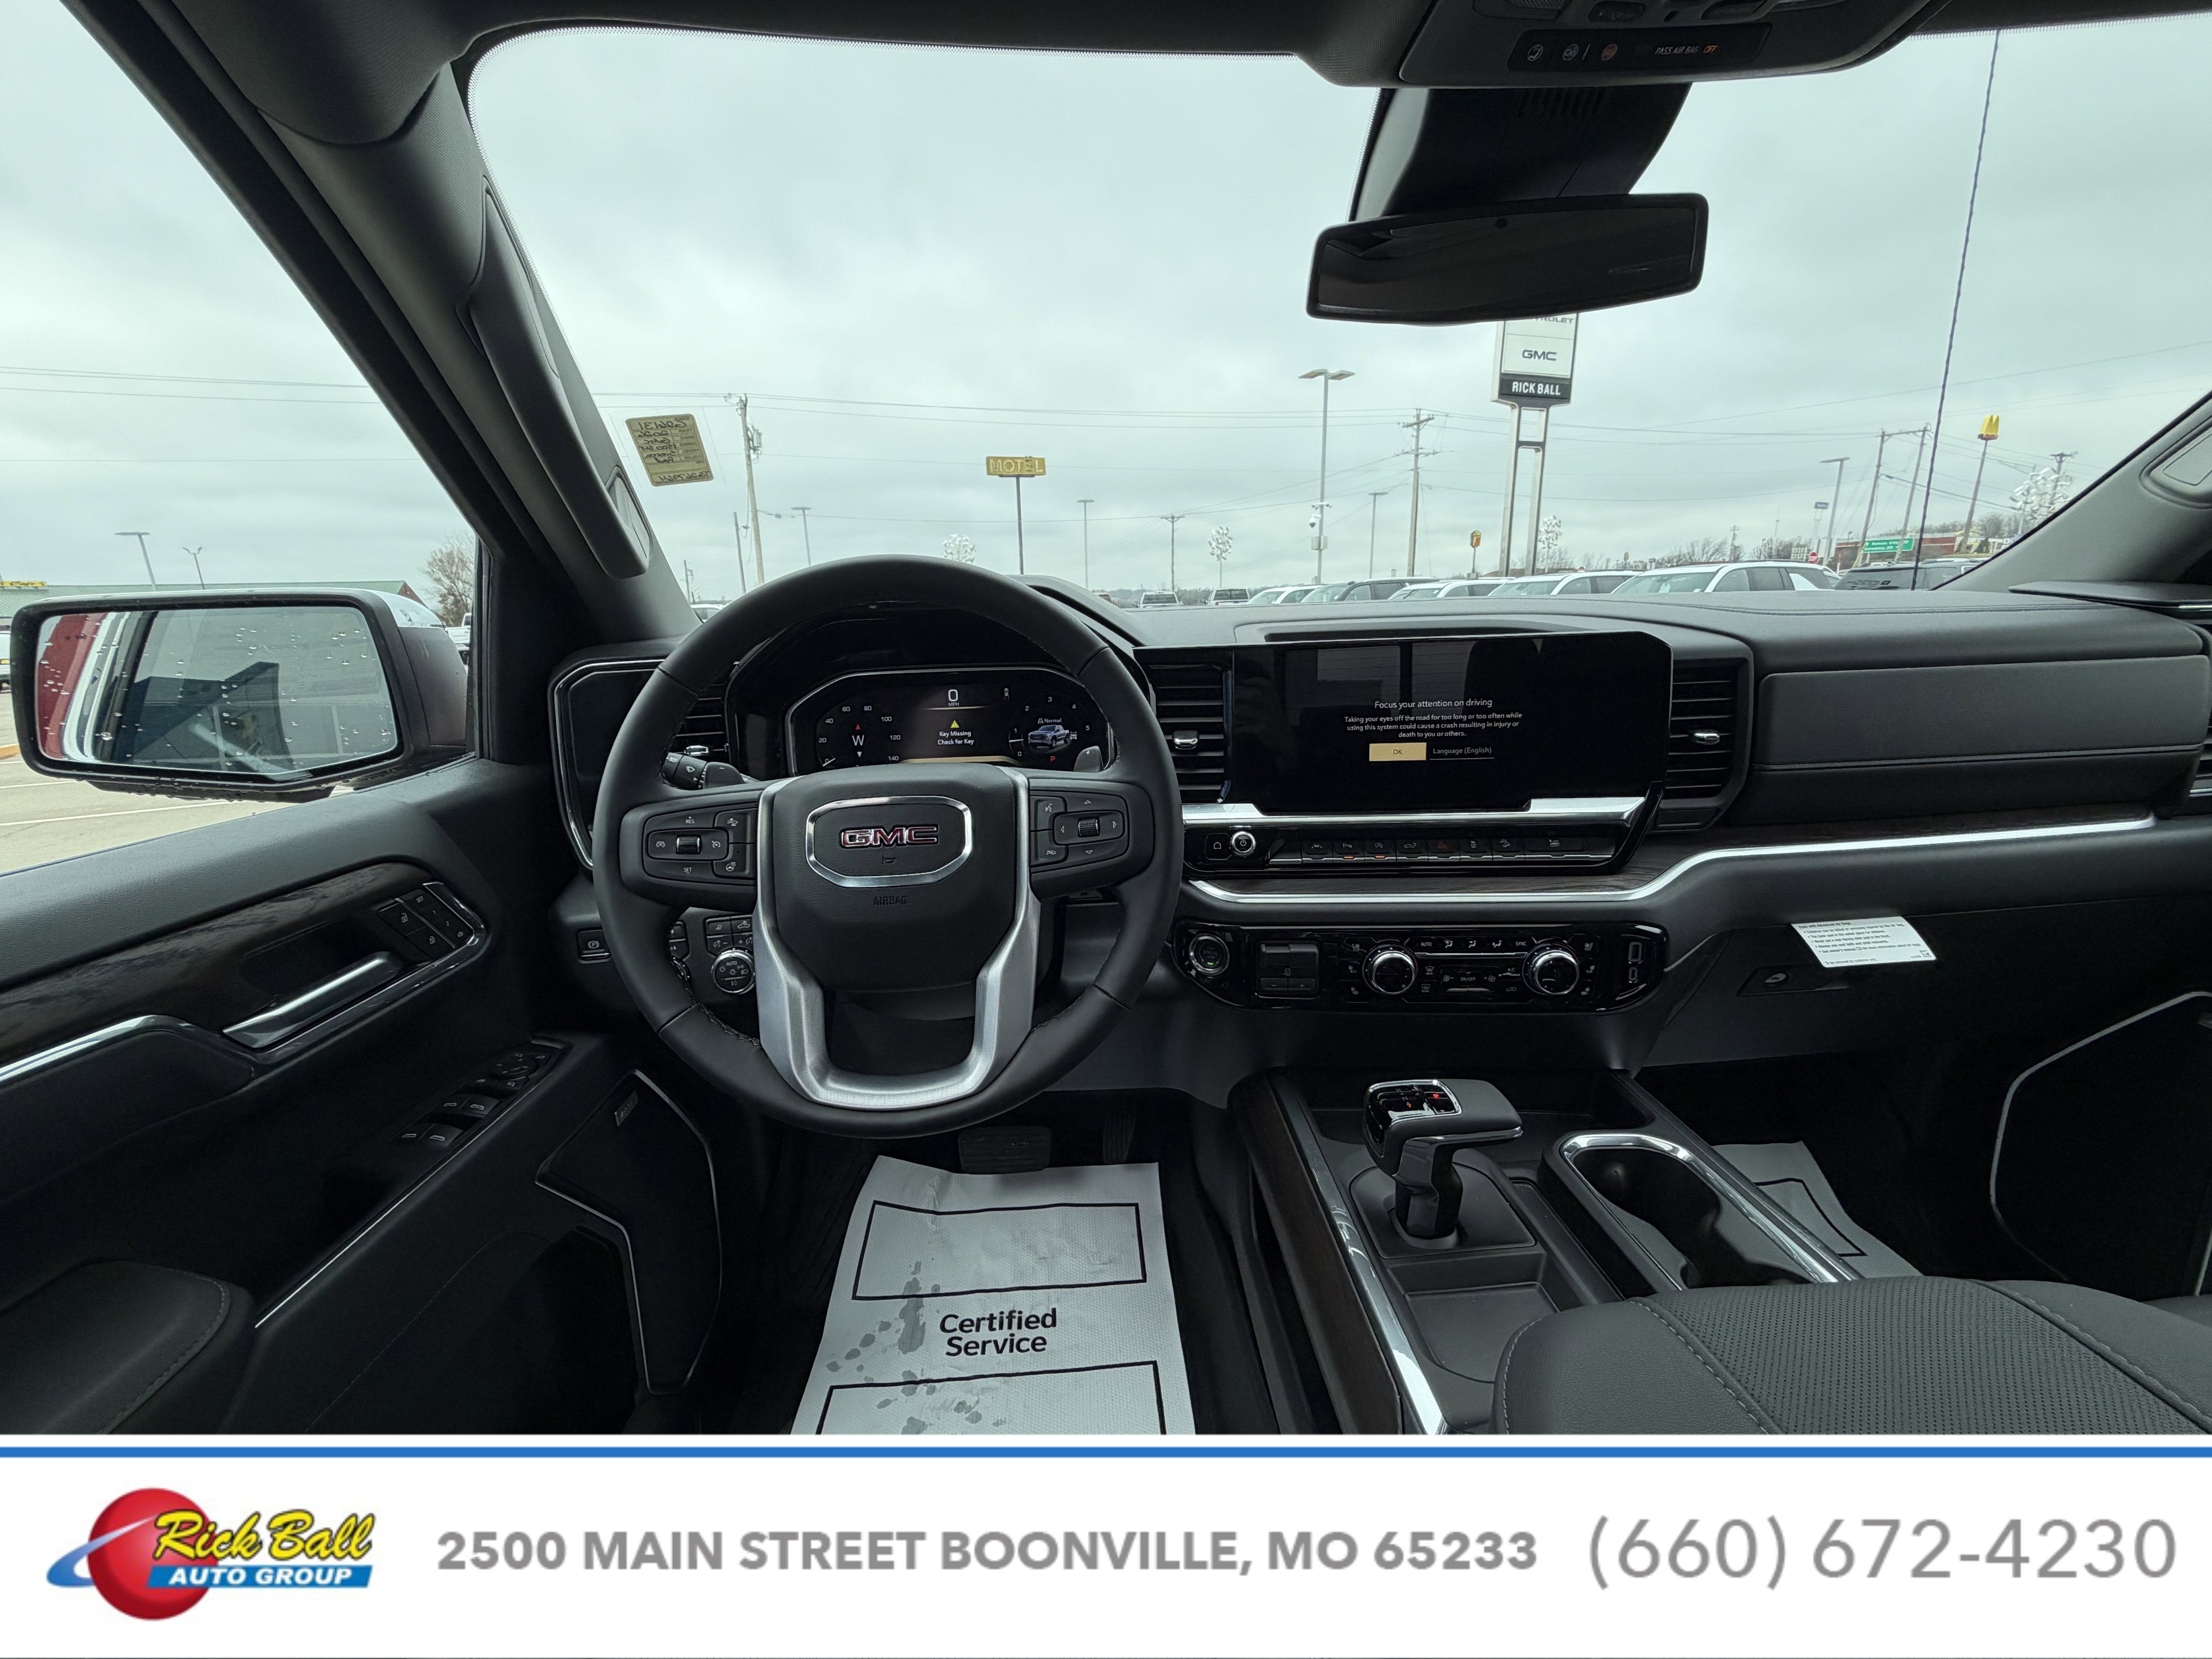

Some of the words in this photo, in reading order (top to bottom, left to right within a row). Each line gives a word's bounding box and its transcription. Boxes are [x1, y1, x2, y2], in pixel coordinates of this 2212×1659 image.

[1704, 45, 1718, 53] OFF
[1522, 349, 1557, 361] GMC
[1512, 381, 1535, 394] RICK
[1537, 383, 1561, 395] BALL
[989, 459, 1044, 472] MOTEL
[948, 689, 958, 701] 0
[1466, 699, 1492, 708] driving
[852, 735, 865, 746] W
[841, 826, 937, 847] GMC
[874, 896, 907, 906] AIRBAG
[940, 1307, 1057, 1333] Certified
[945, 1334, 1047, 1357] Service
